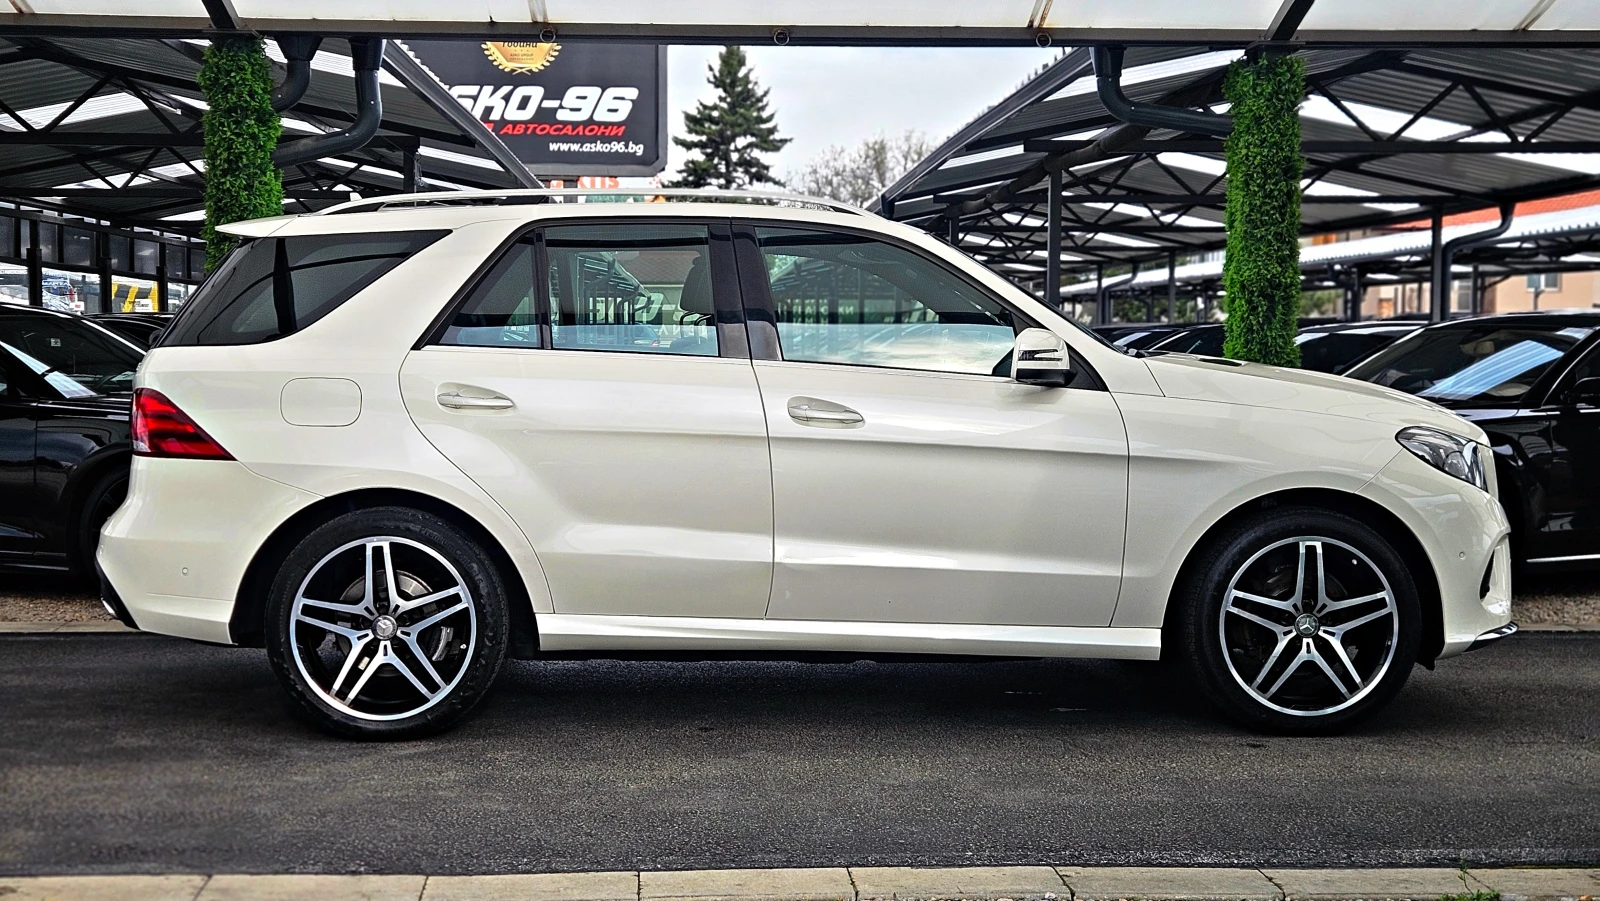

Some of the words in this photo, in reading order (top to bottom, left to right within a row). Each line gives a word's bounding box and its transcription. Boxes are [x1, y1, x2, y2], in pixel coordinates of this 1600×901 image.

[446, 85, 639, 122] SKO-96
[499, 123, 626, 137] АВТОСАЛОНИ
[549, 140, 644, 156] www.asko96.bg
